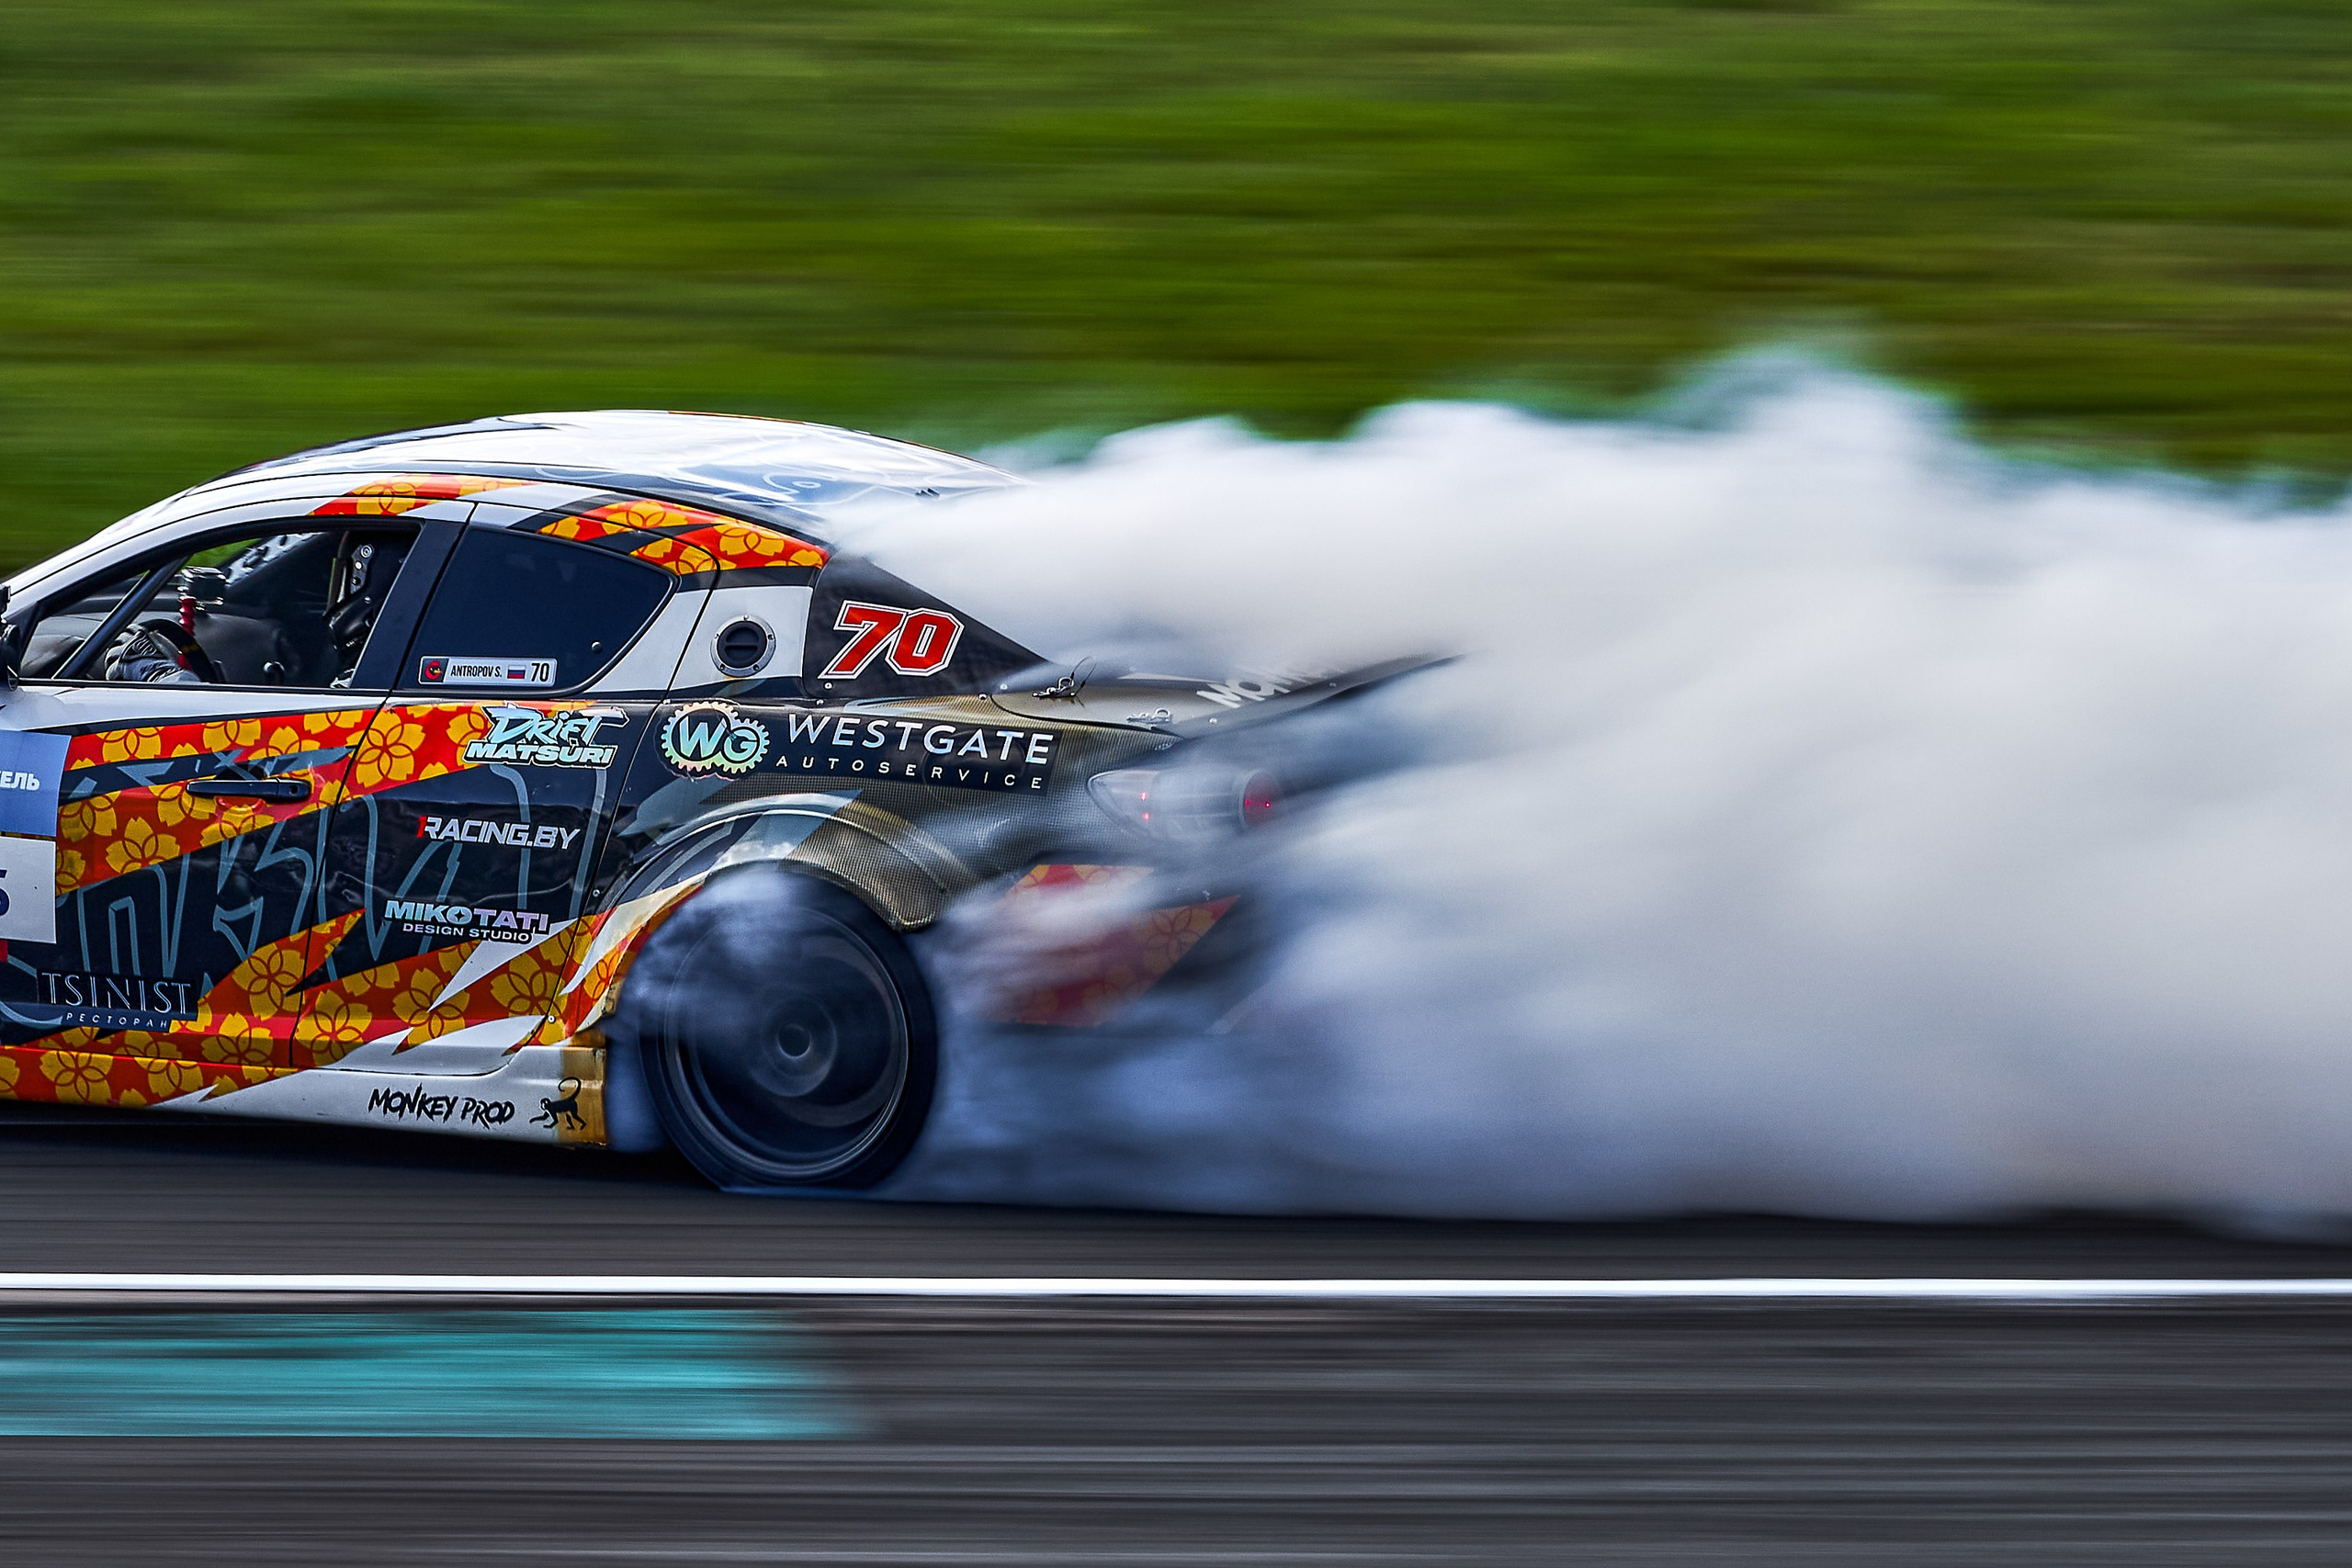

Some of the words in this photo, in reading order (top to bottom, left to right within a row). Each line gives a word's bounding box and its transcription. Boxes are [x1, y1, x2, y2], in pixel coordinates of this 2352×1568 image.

[818, 600, 965, 680] 70
[450, 665, 494, 678] ANTROPOV
[494, 666, 503, 678] S.
[530, 662, 550, 682] 70
[466, 742, 614, 763] MATSURI
[788, 714, 1055, 765] WESTGATE
[0, 770, 40, 791] ЕЛЬ
[775, 755, 1042, 790] AUTOSERVICE
[384, 900, 549, 932] MIKOTATI
[402, 922, 465, 937] DESIGN
[469, 927, 530, 942] STUDIO
[41, 972, 191, 1015] TSINIST
[66, 1012, 167, 1028] РЕСТОРАН
[368, 1082, 458, 1123] MONKEY
[460, 1097, 515, 1129] PROD
